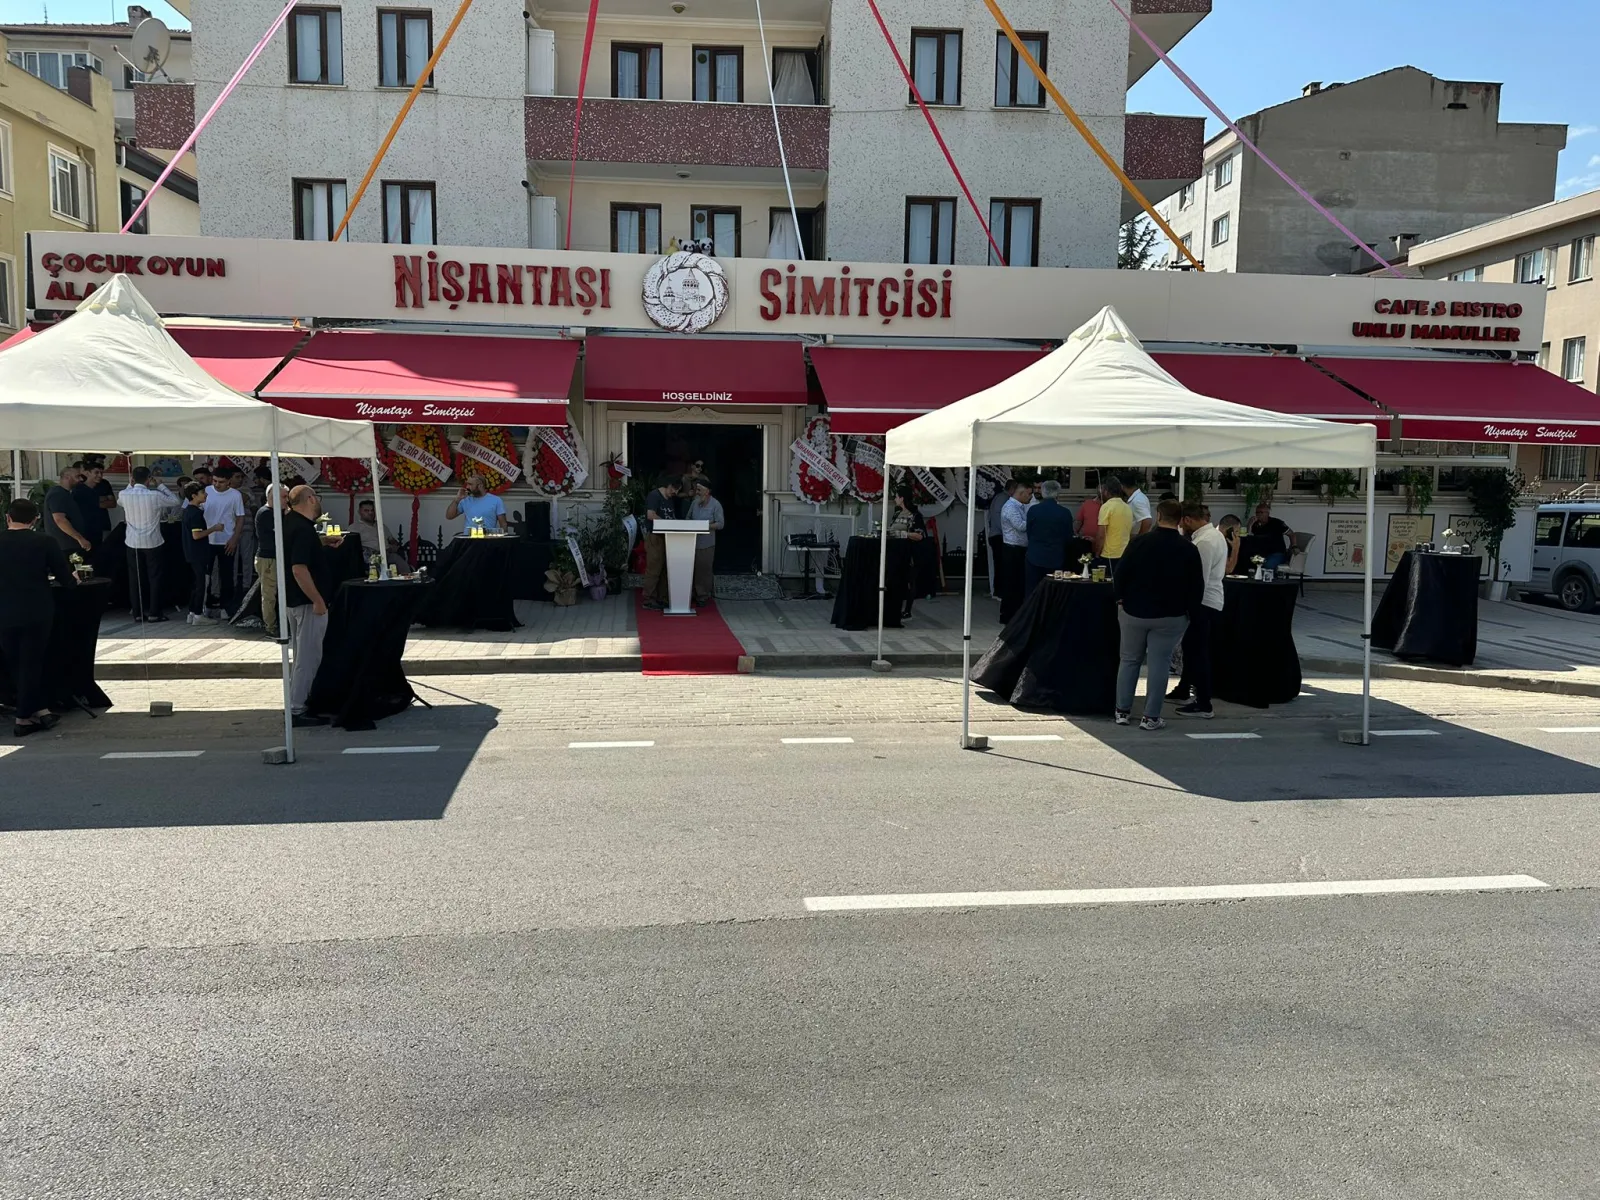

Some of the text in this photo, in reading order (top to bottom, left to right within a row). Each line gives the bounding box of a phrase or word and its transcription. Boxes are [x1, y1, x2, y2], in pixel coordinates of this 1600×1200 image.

[41, 252, 226, 278] ÇOCUK OYUN
[393, 250, 953, 325] NİŞANTAŞI SİMİTÇİSİ
[1374, 298, 1430, 316] CAFE
[1450, 301, 1523, 319] BISTRO
[662, 391, 733, 402] HOŞGELDİNİZ
[355, 401, 475, 420] Nişantaşı Simitçisi
[1535, 426, 1578, 441] Simitçisi
[418, 450, 445, 475] İNŞAAT
[477, 448, 517, 478] MOLLAOĞLU
